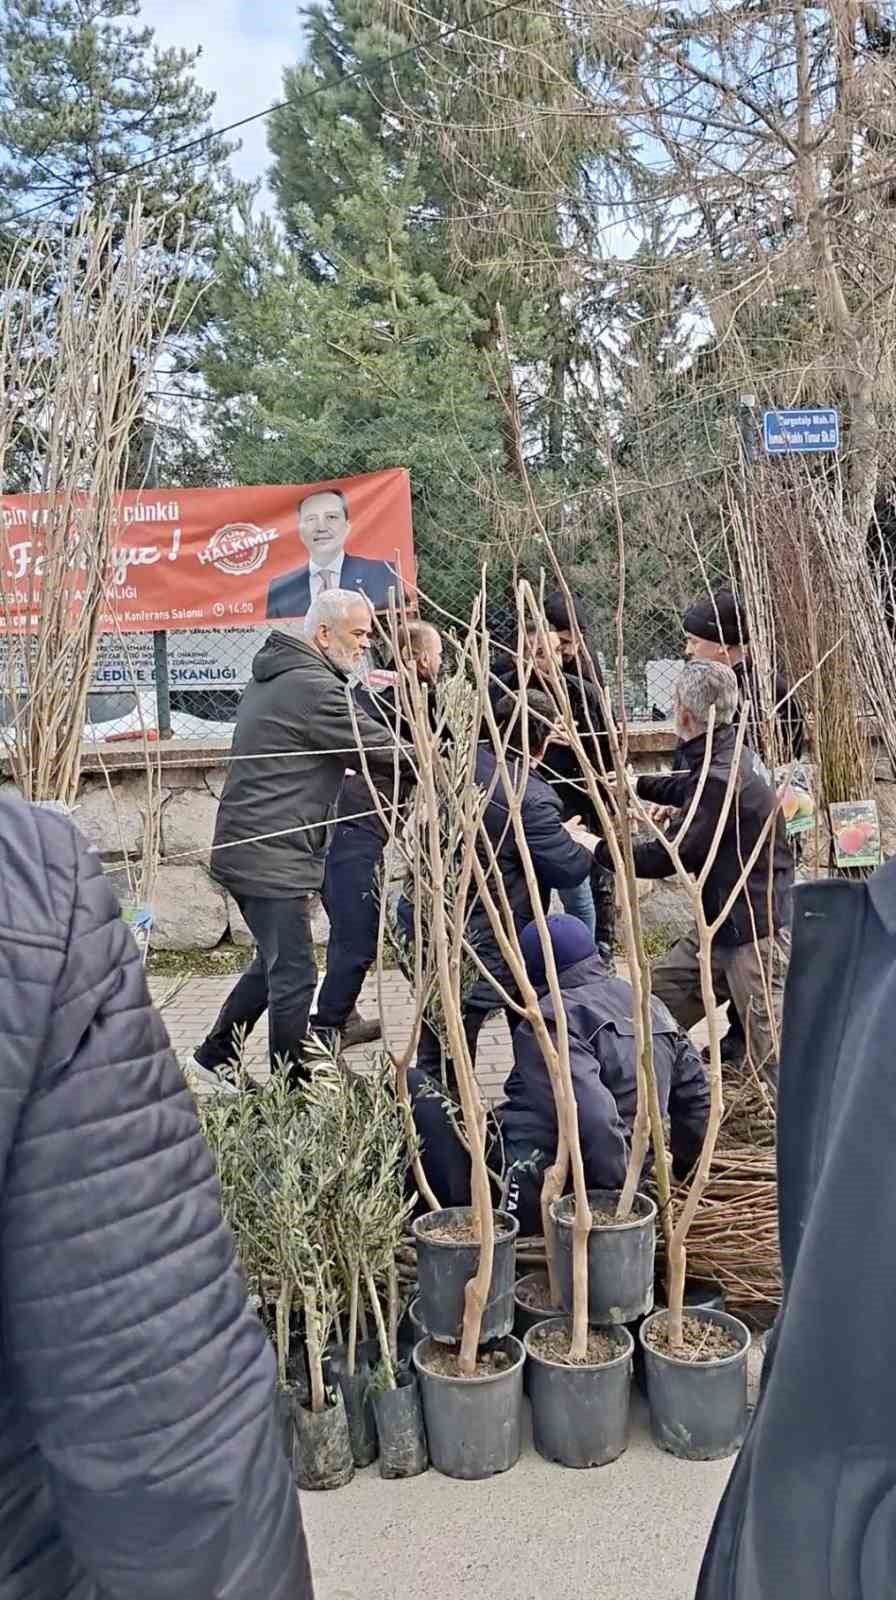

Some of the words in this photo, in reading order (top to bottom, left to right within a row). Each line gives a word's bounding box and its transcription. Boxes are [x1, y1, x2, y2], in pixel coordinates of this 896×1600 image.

[196, 527, 279, 565] HALKIMIZ
[124, 609, 170, 622] Konferans
[171, 606, 203, 619] Salonu
[228, 602, 254, 614] 14:00
